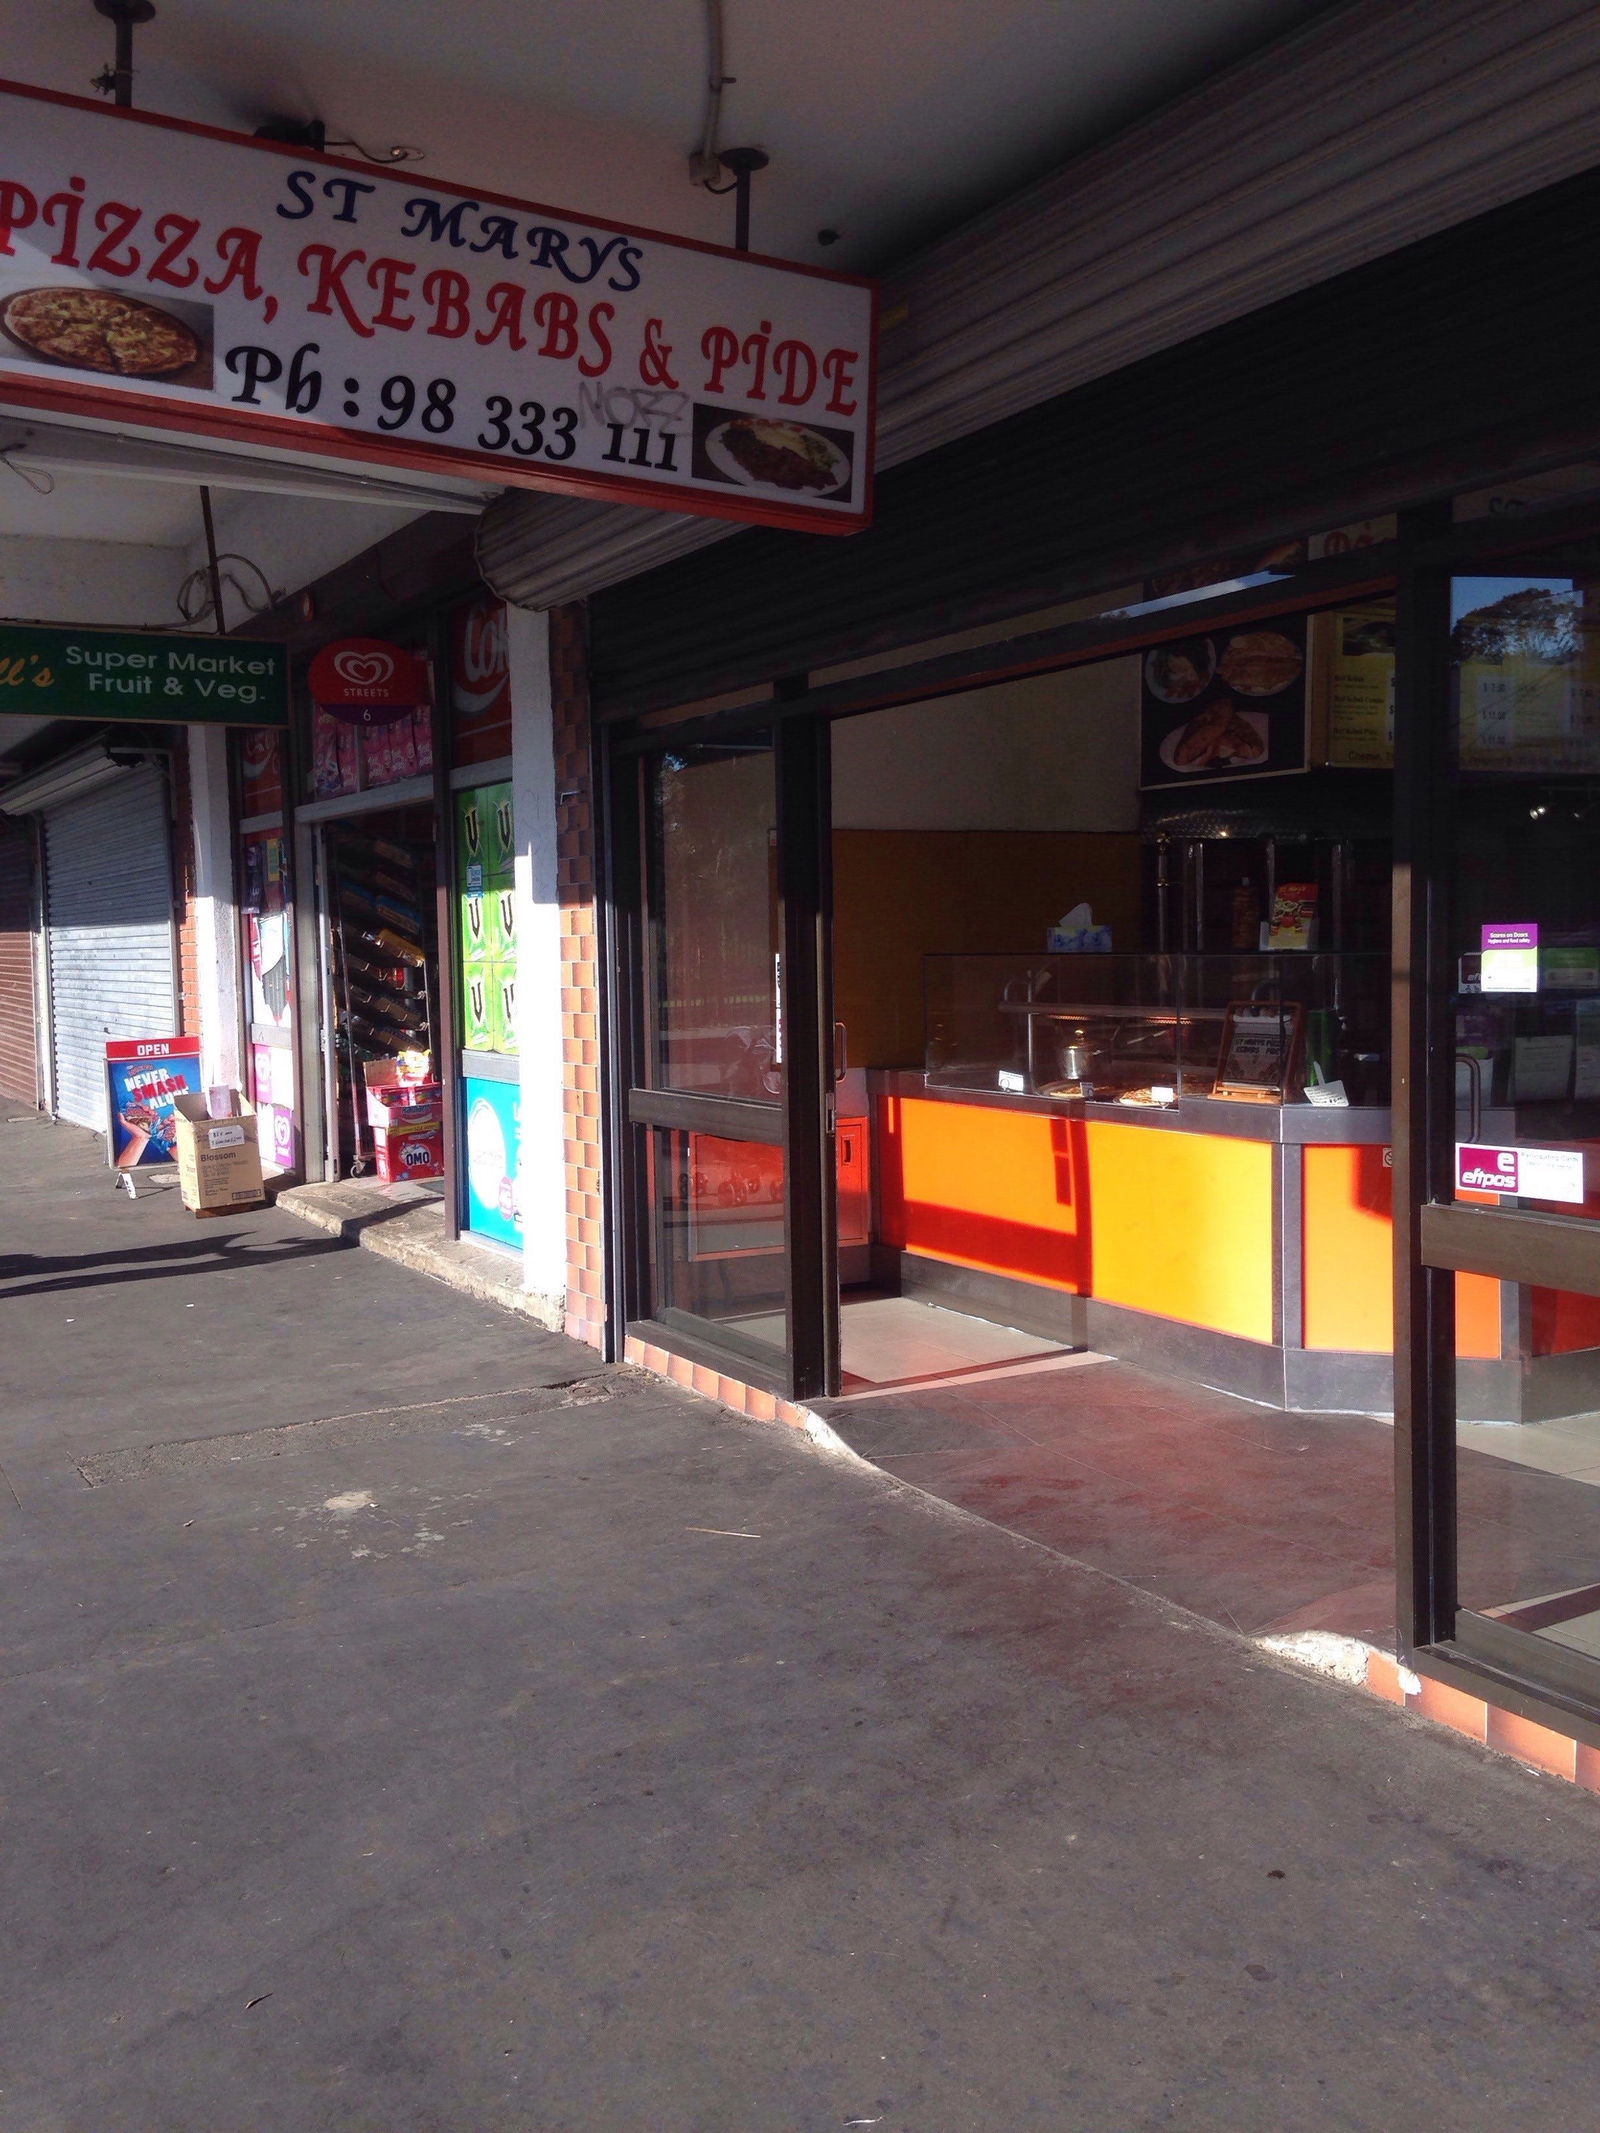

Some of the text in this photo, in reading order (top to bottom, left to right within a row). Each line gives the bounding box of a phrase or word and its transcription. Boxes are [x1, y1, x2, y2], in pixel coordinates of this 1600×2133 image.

[276, 170, 645, 293] ST MARYS
[298, 241, 617, 378] KEBABS
[638, 317, 681, 391] &
[477, 395, 580, 462] 333
[601, 422, 678, 473] 111
[66, 646, 158, 671] Super
[168, 652, 276, 676] Market
[88, 673, 267, 704] Fruit & Veg.
[343, 687, 390, 698] STREETS
[362, 708, 372, 722] 6
[137, 1043, 170, 1056] OPEN
[124, 1068, 170, 1091] NEVER
[132, 1075, 187, 1102] SMASH
[200, 1152, 237, 1162] Blossom
[406, 1151, 430, 1166] OMO
[1497, 1152, 1515, 1173] e
[1462, 1168, 1516, 1188] eftpos
